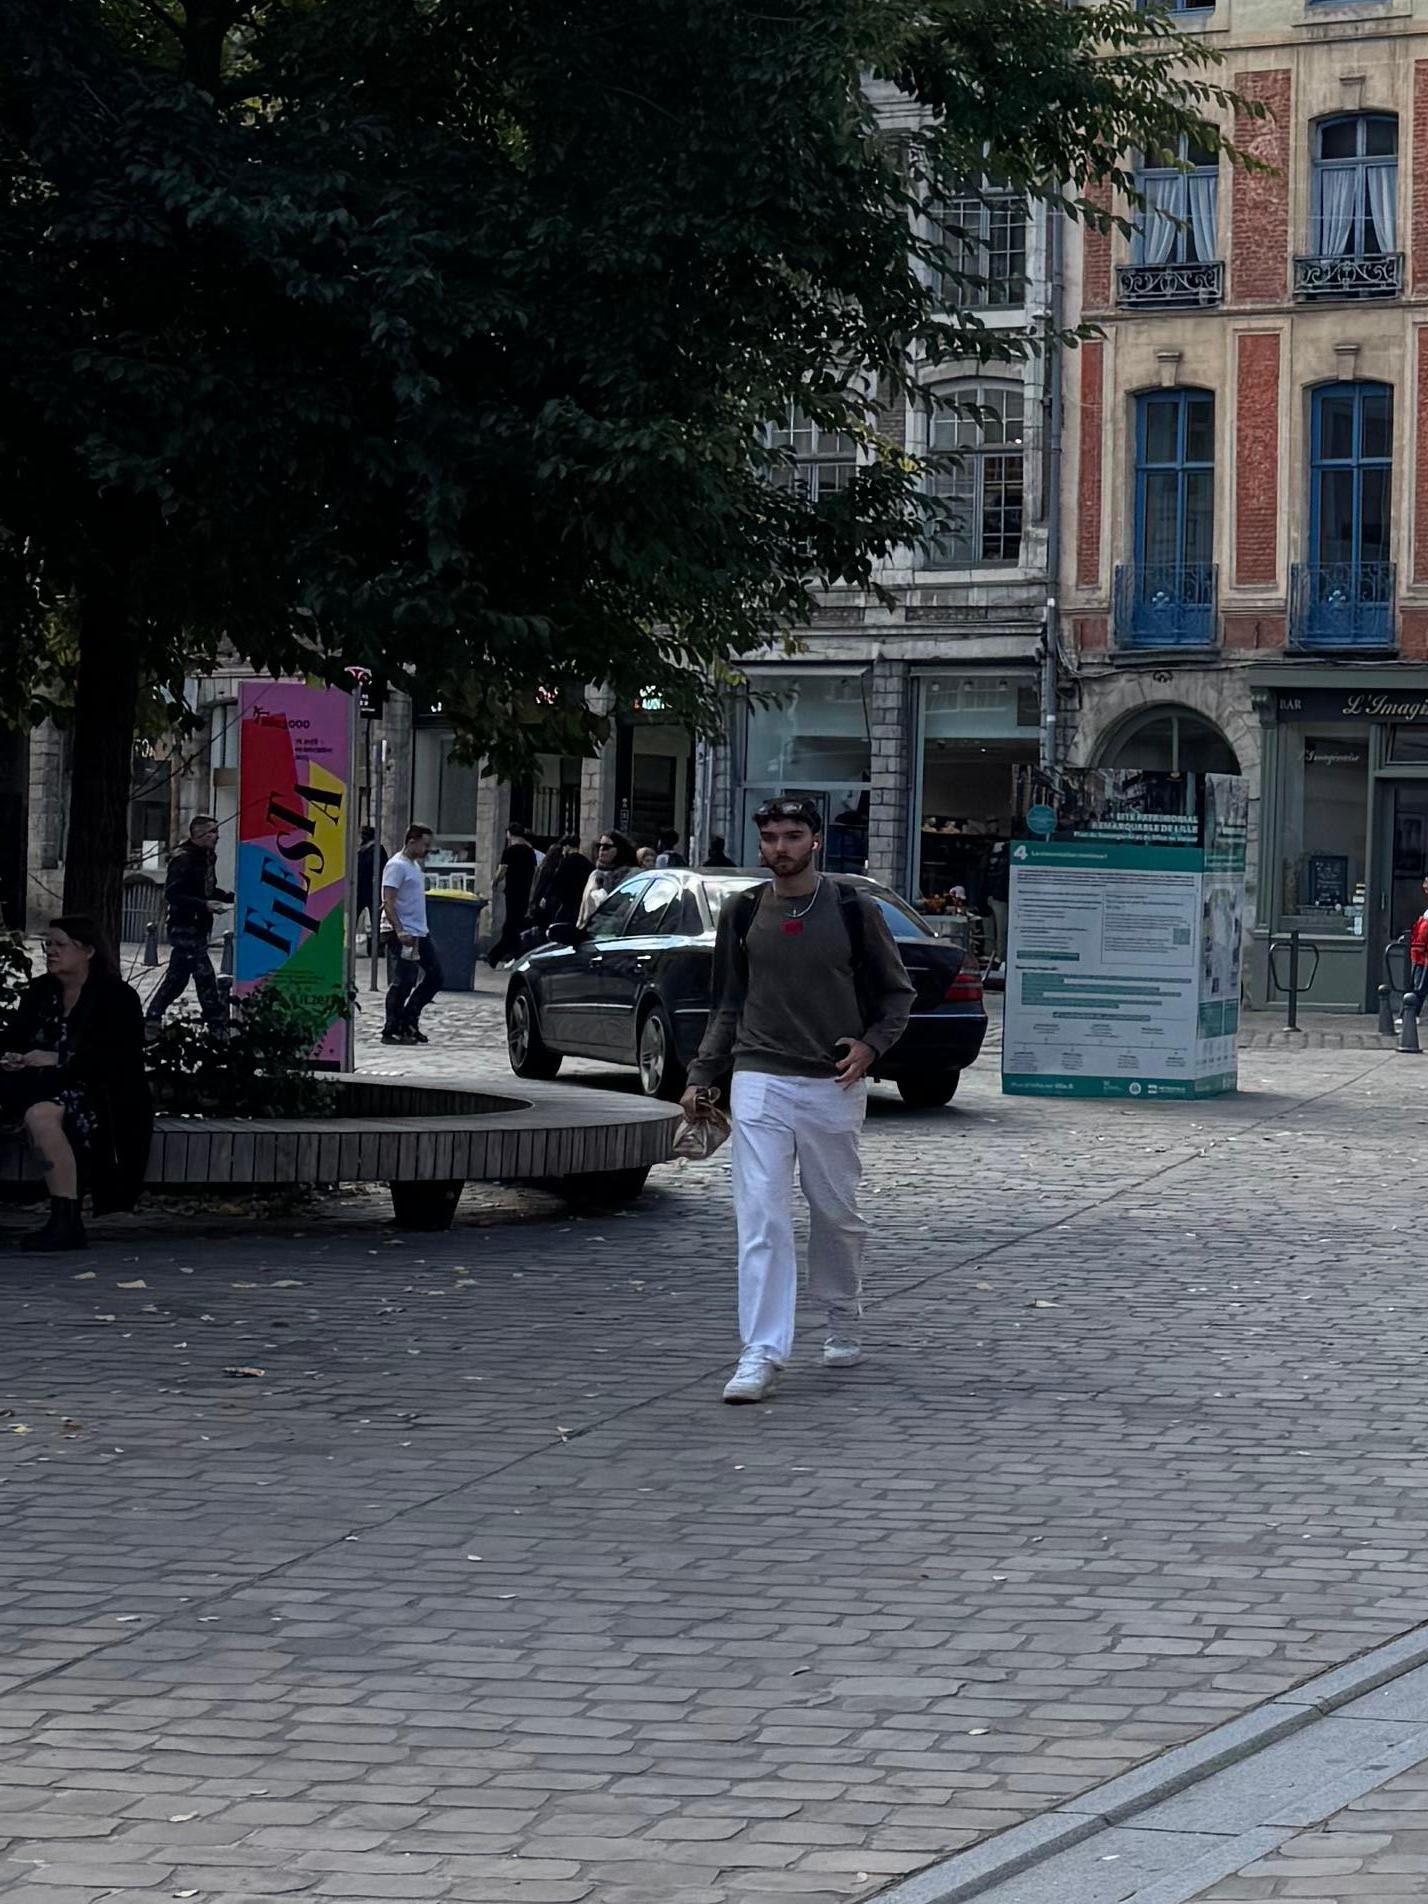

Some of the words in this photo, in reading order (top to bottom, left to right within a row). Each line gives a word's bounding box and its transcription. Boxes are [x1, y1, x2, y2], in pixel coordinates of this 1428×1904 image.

[1279, 698, 1302, 710] BAR
[1013, 844, 1028, 861] 4
[244, 783, 343, 957] FIESTA
